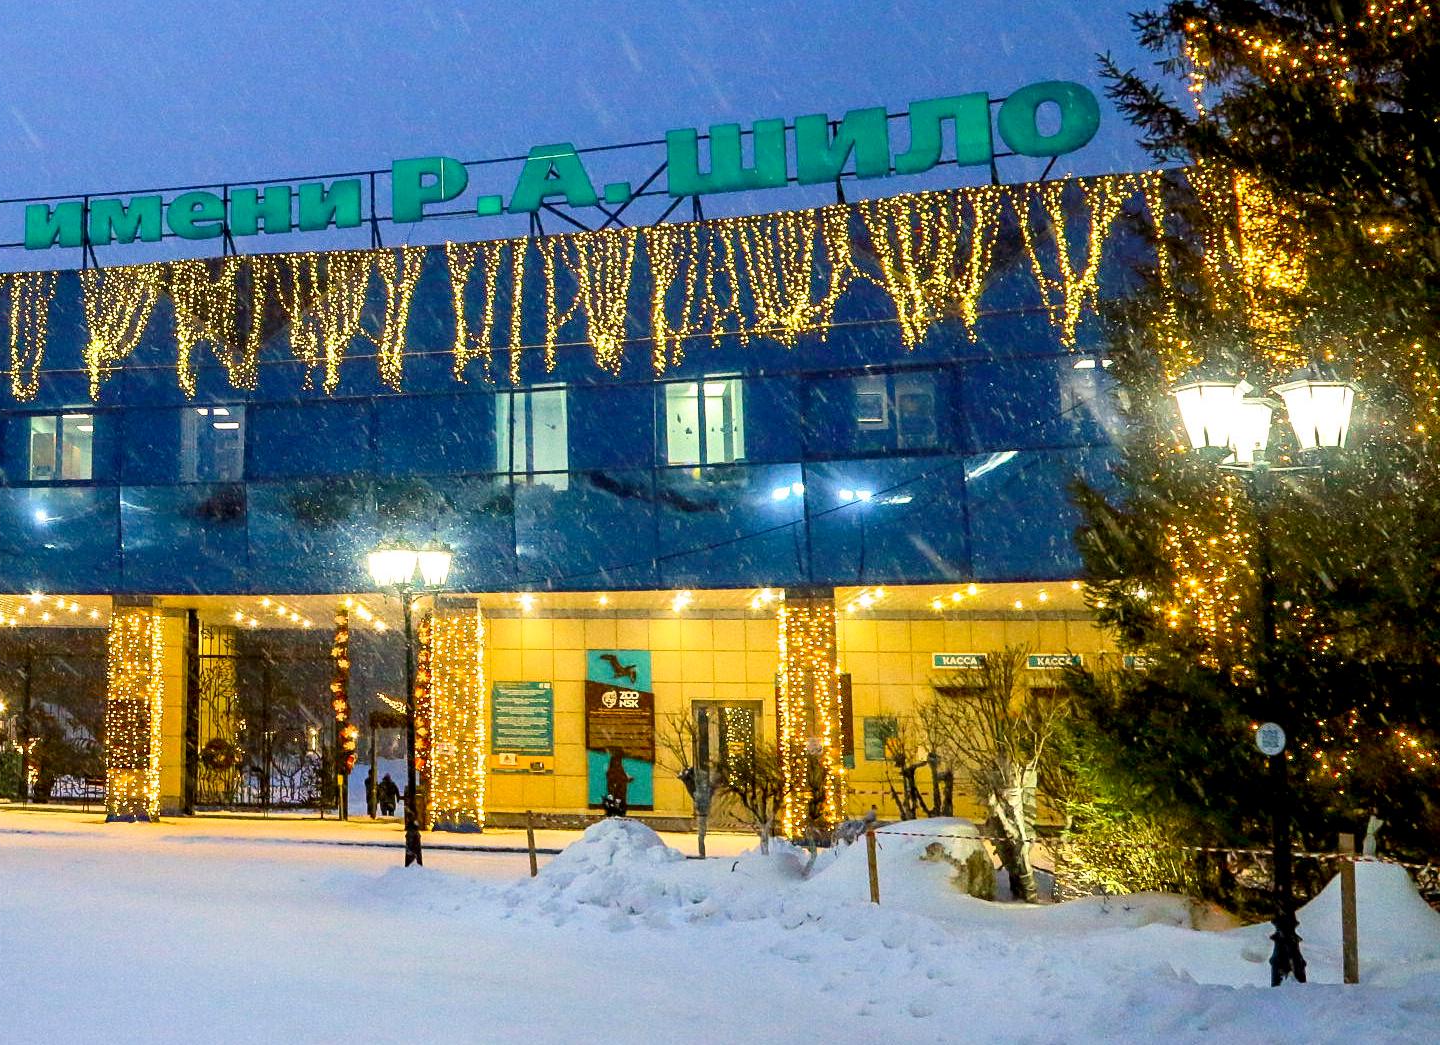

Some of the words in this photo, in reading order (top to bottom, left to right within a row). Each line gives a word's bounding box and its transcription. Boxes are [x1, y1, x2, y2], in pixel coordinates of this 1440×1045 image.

[24, 178, 362, 250] имени
[392, 142, 631, 223] Р.А.
[665, 79, 1101, 198] ШИЛО
[942, 656, 978, 665] КАССА
[619, 691, 639, 699] ZOO
[619, 700, 639, 708] NSK
